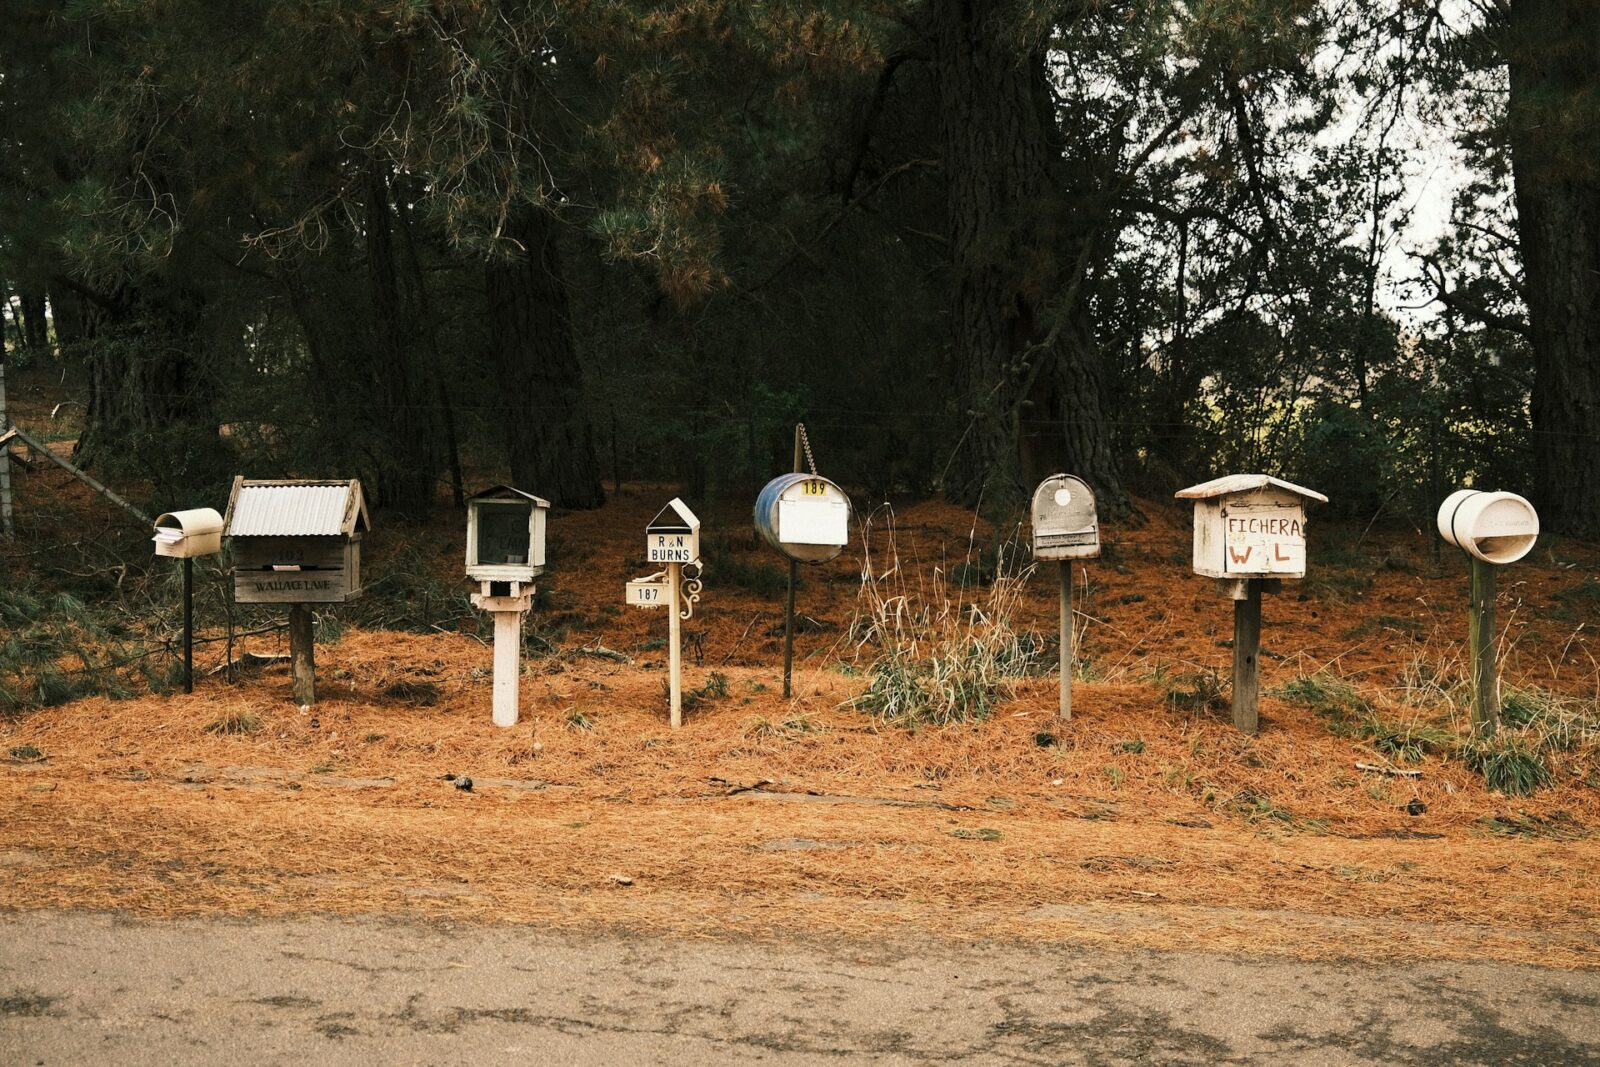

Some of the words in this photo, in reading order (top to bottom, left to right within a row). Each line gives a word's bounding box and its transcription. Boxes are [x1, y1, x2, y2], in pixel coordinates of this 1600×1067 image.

[804, 482, 825, 494] 189
[1228, 518, 1301, 537] FICHERA
[658, 536, 665, 547] R
[677, 536, 683, 547] N
[278, 550, 304, 561] 102
[652, 549, 690, 561] BURNS
[1229, 545, 1252, 564] W
[1275, 542, 1290, 562] L
[255, 581, 303, 592] WALLACE
[304, 580, 331, 591] LANE
[638, 588, 658, 600] 187
